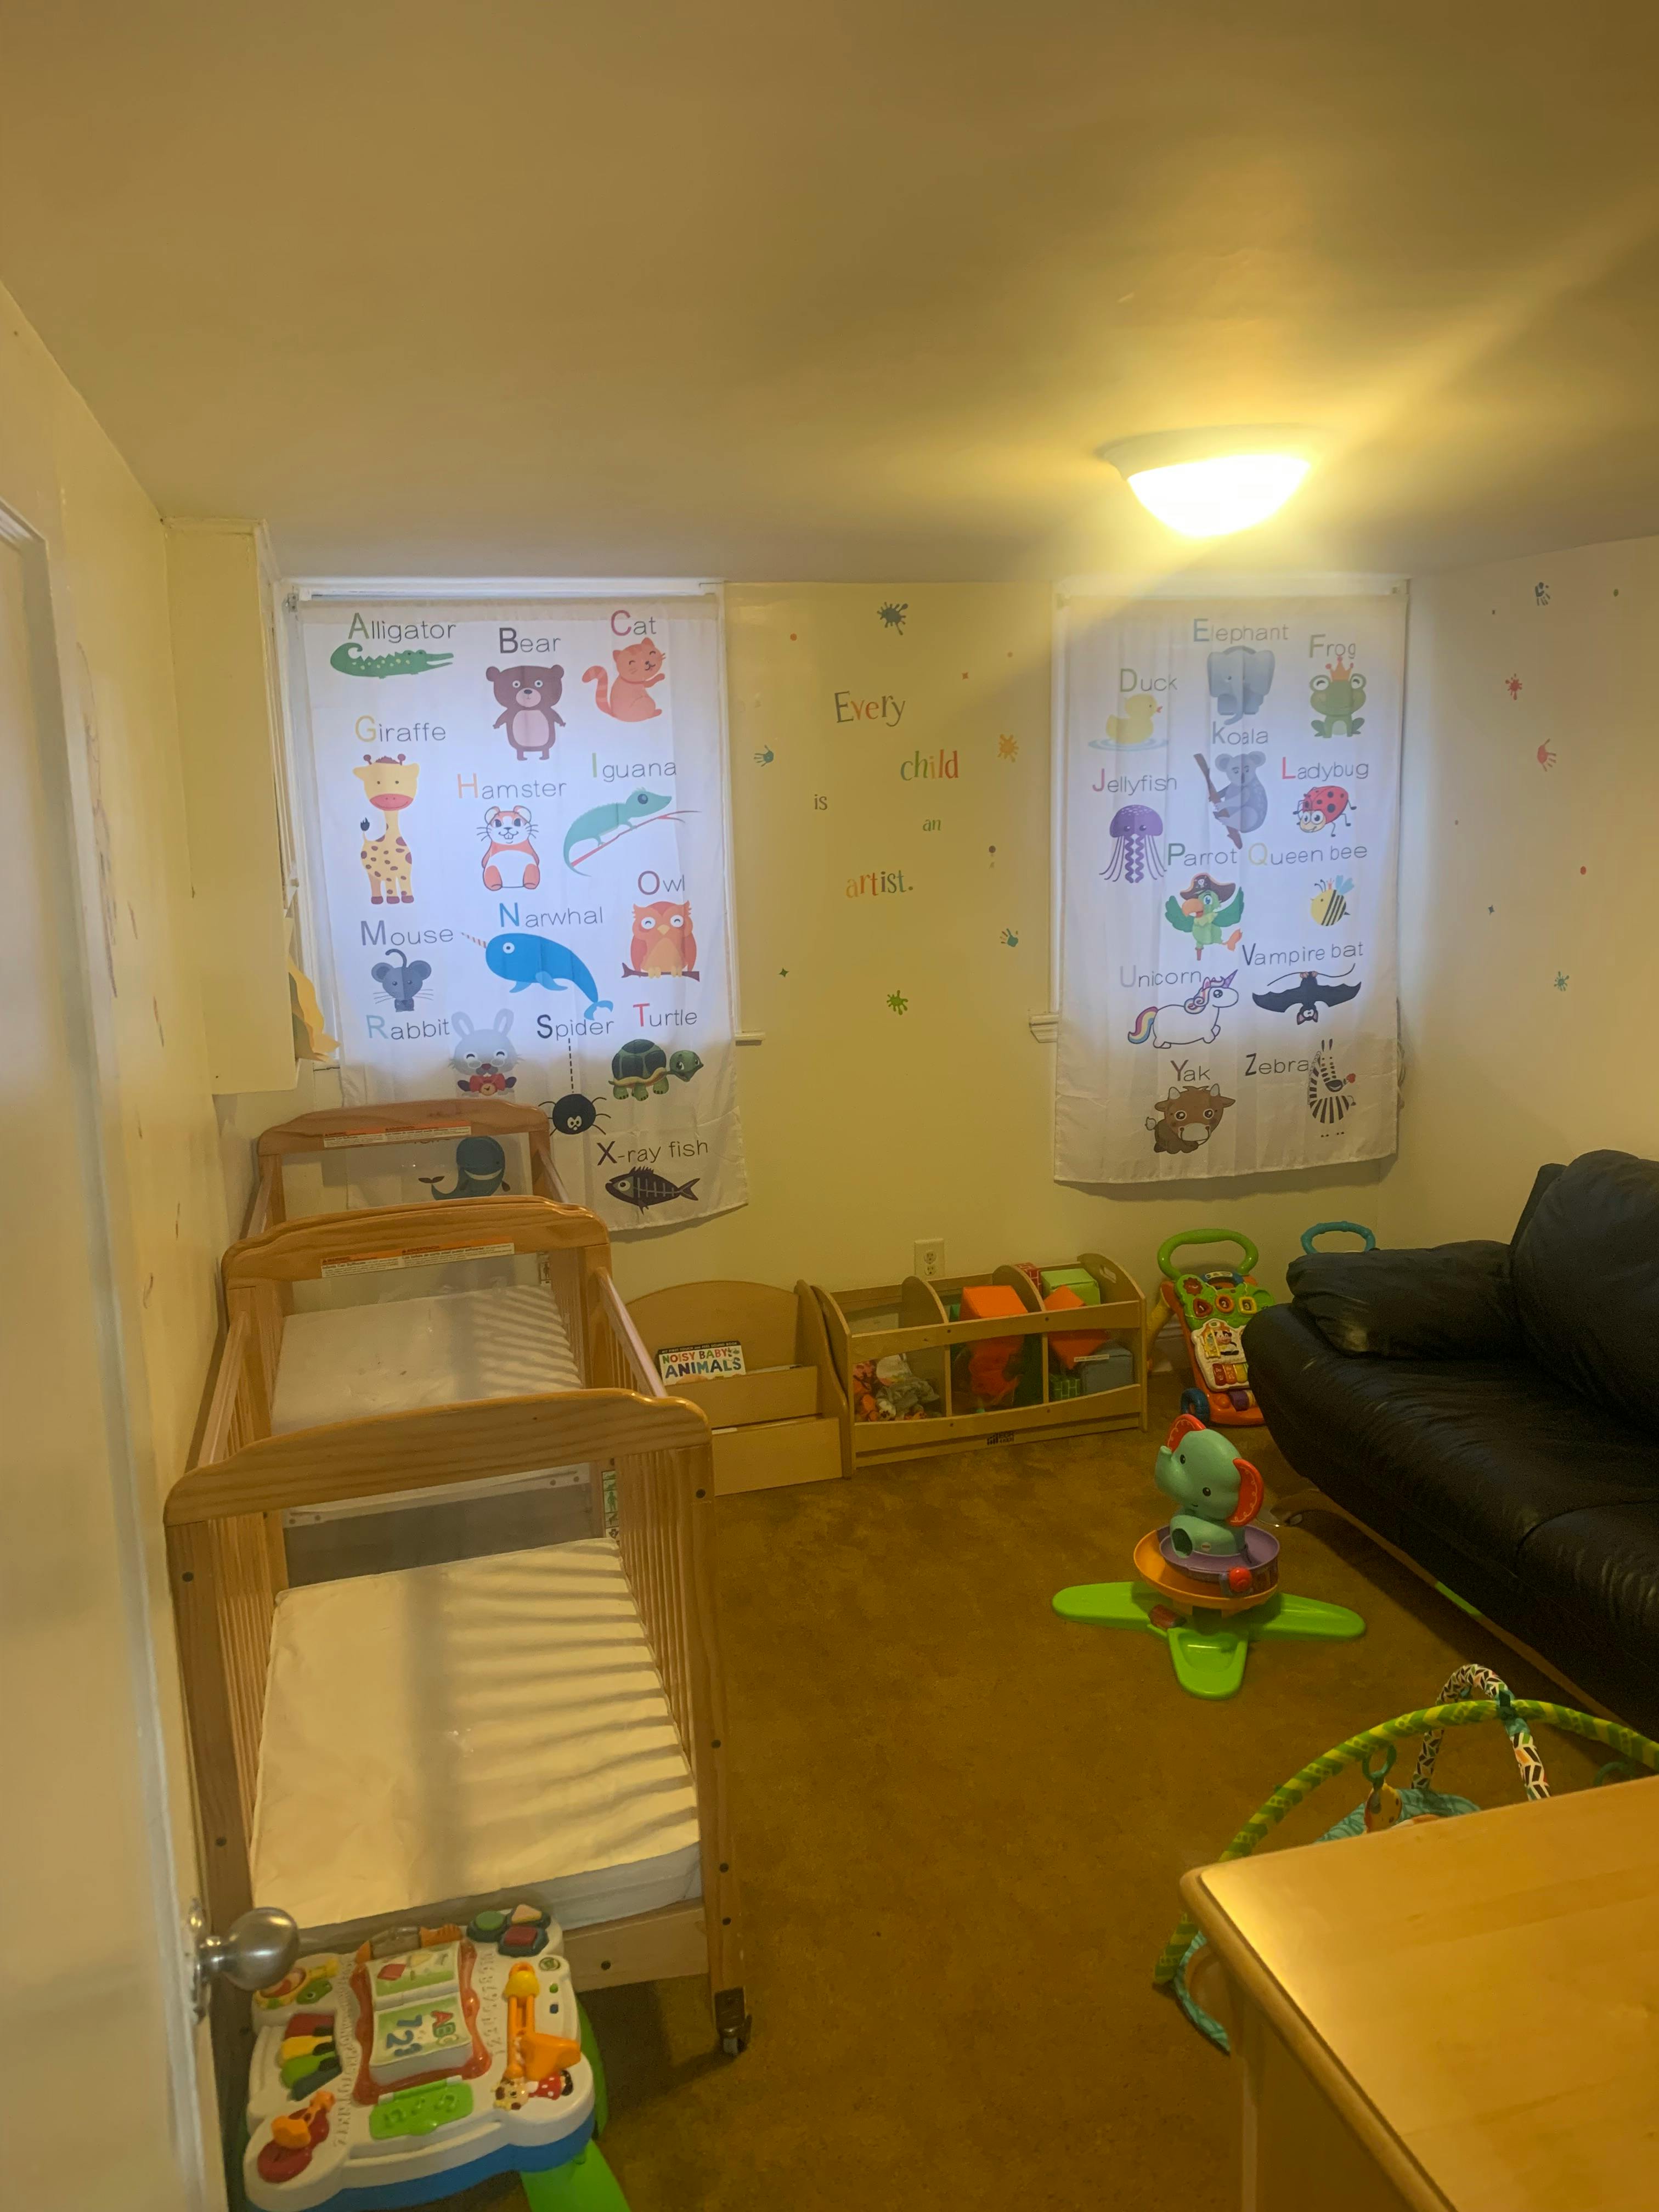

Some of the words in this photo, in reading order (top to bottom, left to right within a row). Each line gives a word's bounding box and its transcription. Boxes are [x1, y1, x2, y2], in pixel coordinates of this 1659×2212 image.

[348, 612, 456, 643] Alligator
[610, 610, 657, 636] Cat
[1193, 619, 1289, 644] Elephant
[499, 627, 561, 654] Bear
[1309, 634, 1356, 659] Frog
[1120, 669, 1178, 693] Duck
[834, 691, 906, 727] Every
[355, 715, 446, 742] Giraffe
[1212, 721, 1268, 745] Koala
[591, 753, 676, 782] Iguana
[900, 749, 960, 781] child
[1281, 757, 1369, 781] Ladybug
[458, 773, 566, 799] Hamster
[1092, 768, 1177, 795] Jellyfish
[814, 794, 828, 810] is
[922, 818, 941, 831] an
[1167, 843, 1238, 866] Parrot
[1248, 842, 1323, 866] Queen
[1330, 845, 1368, 861] bee
[637, 870, 685, 894] Owl
[845, 870, 913, 898] artist.
[499, 902, 603, 928] Narwhal
[360, 920, 454, 946] Mouse
[1242, 943, 1325, 967] Vampire
[1331, 941, 1364, 958] bat
[1120, 965, 1201, 988] Unicorn
[366, 1014, 450, 1041] Rabbit
[537, 1014, 614, 1041] Spider
[633, 1003, 698, 1028] Turtle
[1170, 1059, 1210, 1082] Yak
[1245, 1053, 1310, 1076] Zebra
[597, 1141, 661, 1166] X-ray
[668, 1139, 708, 1159] fish
[662, 1351, 695, 1364] NOISY
[698, 1348, 727, 1359] BABY
[665, 1357, 741, 1379] ANIMALS
[430, 2010, 460, 2046] ABC
